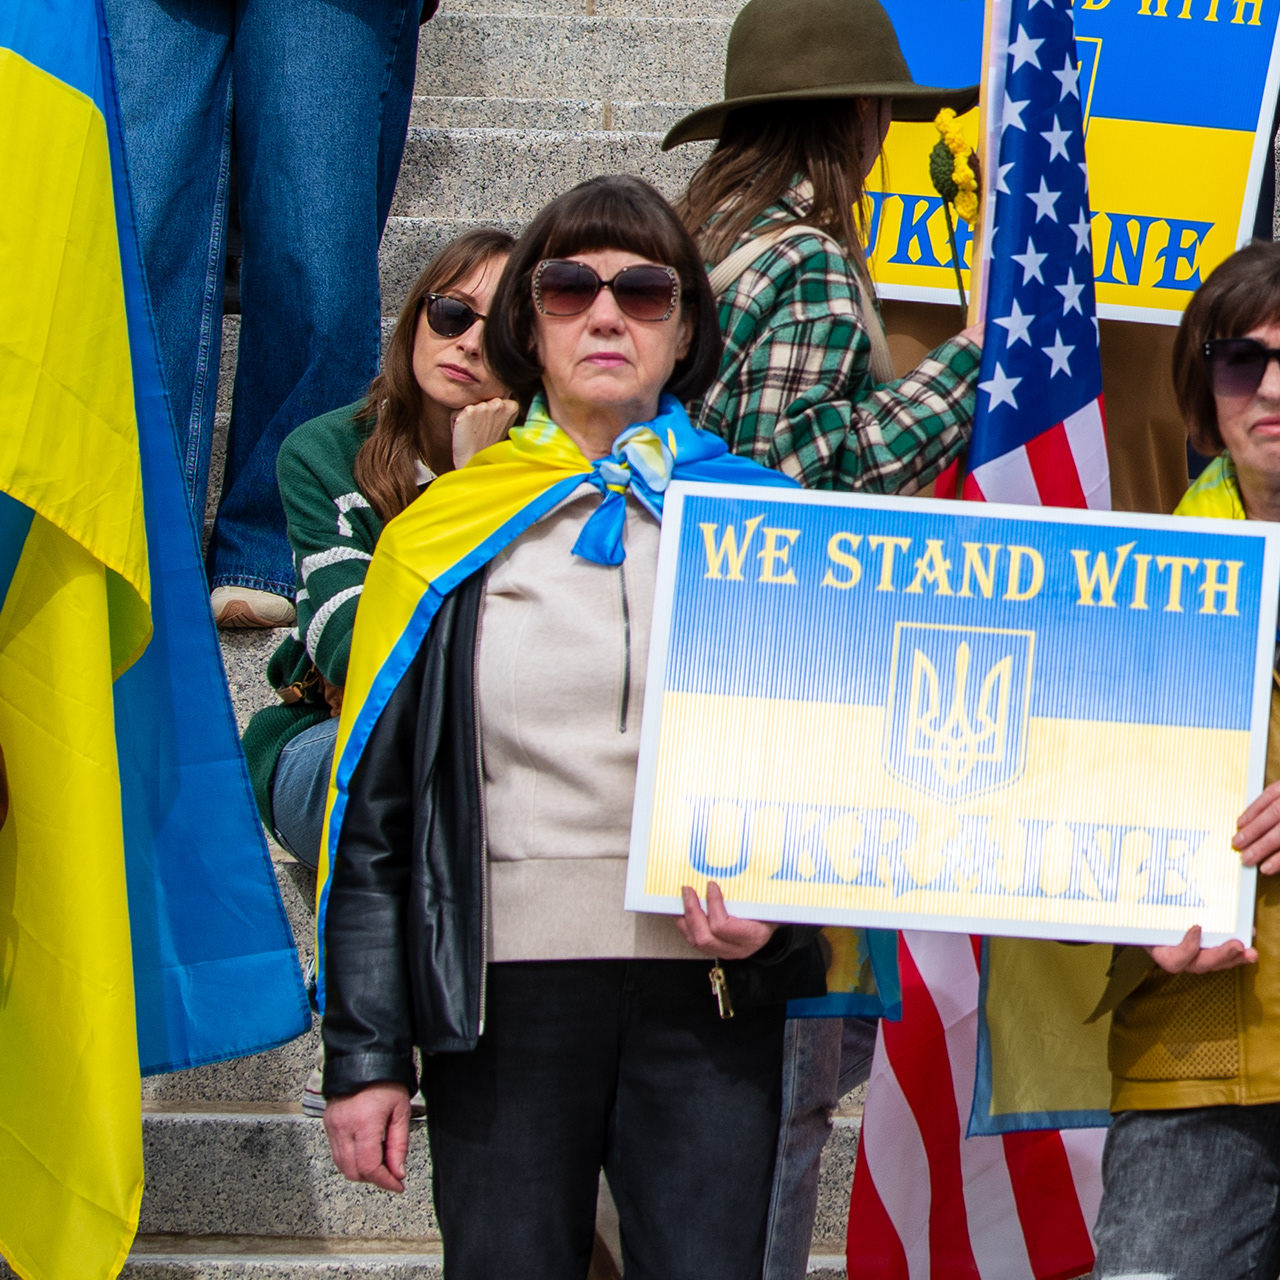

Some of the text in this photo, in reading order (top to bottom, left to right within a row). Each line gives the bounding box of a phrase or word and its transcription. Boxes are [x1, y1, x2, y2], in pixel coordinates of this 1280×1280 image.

[698, 512, 1244, 616] WE STAND WITH
[683, 794, 1211, 910] UKRAINE
